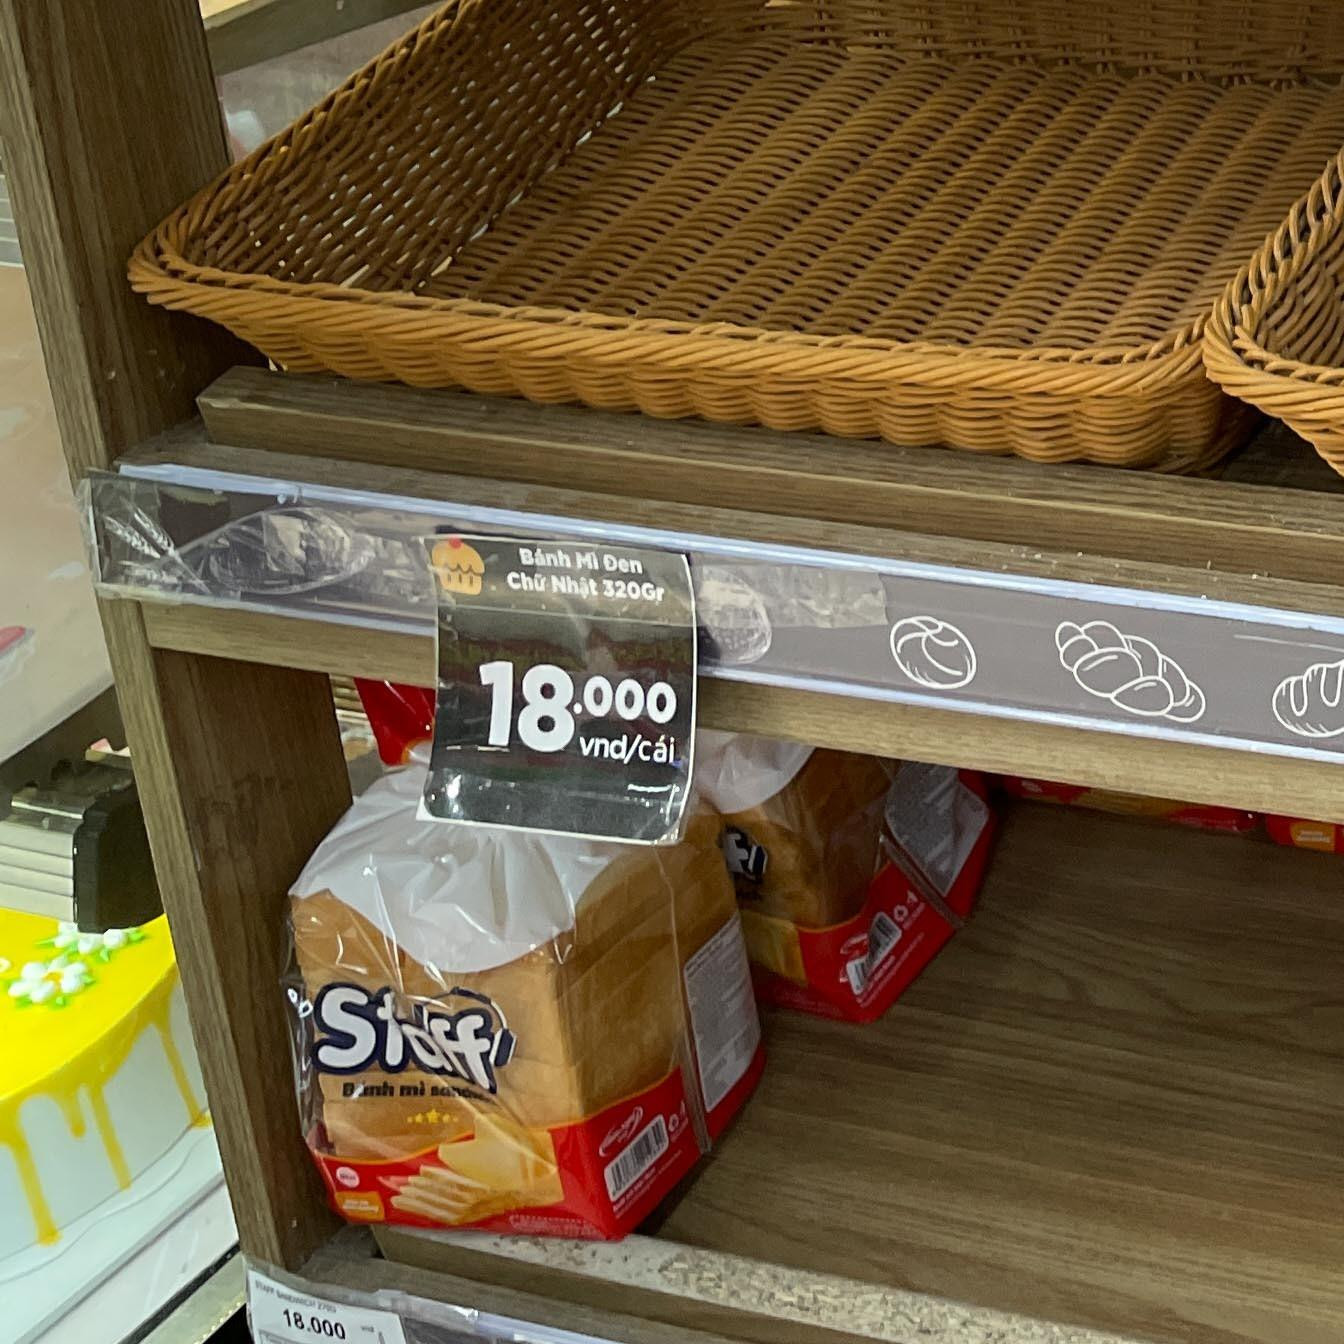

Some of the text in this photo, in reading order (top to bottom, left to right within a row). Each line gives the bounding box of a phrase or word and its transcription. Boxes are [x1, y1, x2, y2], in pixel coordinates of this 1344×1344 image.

[519, 548, 642, 574] Bánh Mì Đen
[507, 569, 665, 603] Chữ Nhật 320Gr
[479, 660, 677, 753] 18.000
[580, 734, 675, 764] vnd/cái
[283, 1308, 346, 1340] 18.000
